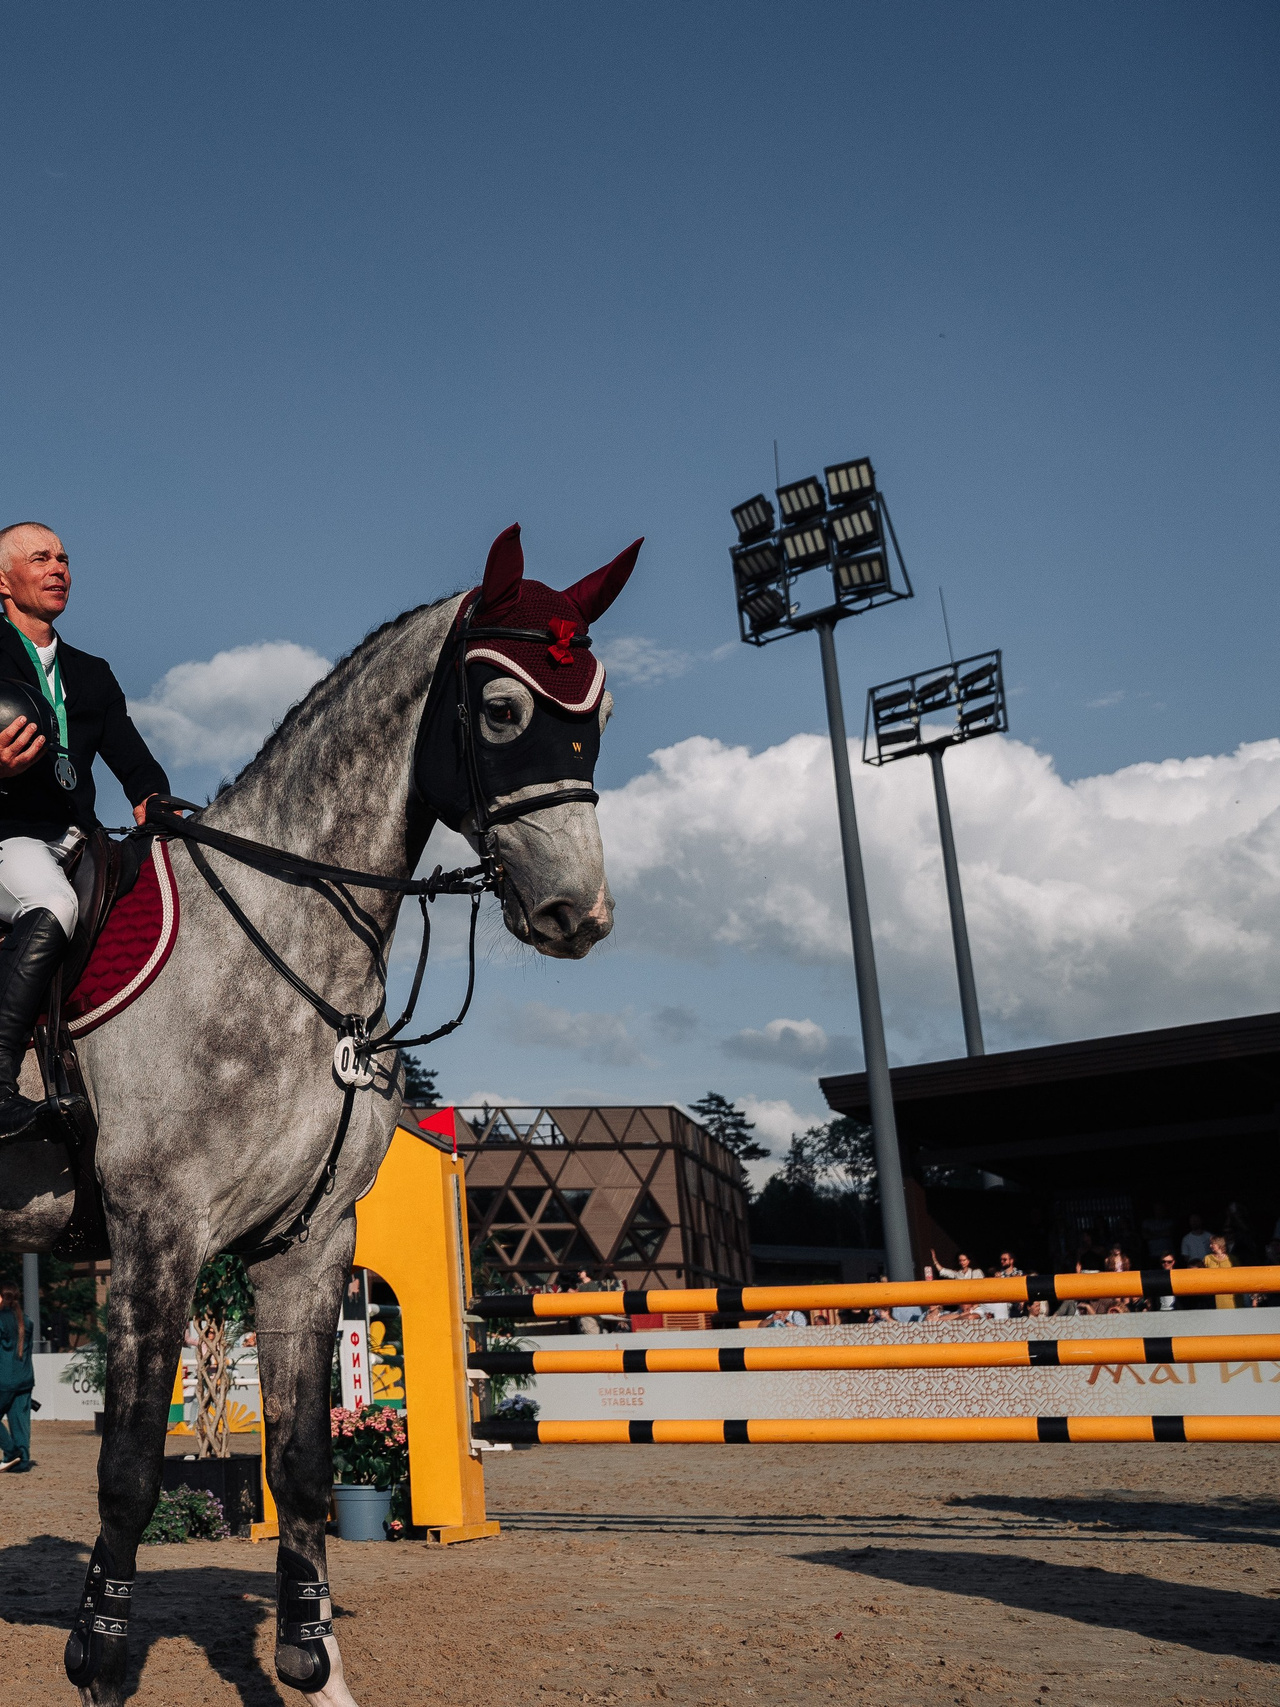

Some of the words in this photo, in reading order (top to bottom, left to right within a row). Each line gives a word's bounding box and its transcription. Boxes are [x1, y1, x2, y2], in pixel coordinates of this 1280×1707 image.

[350, 1331, 363, 1409] ФИНИ
[598, 1387, 645, 1396] EMERALD
[601, 1398, 644, 1406] STABLES
